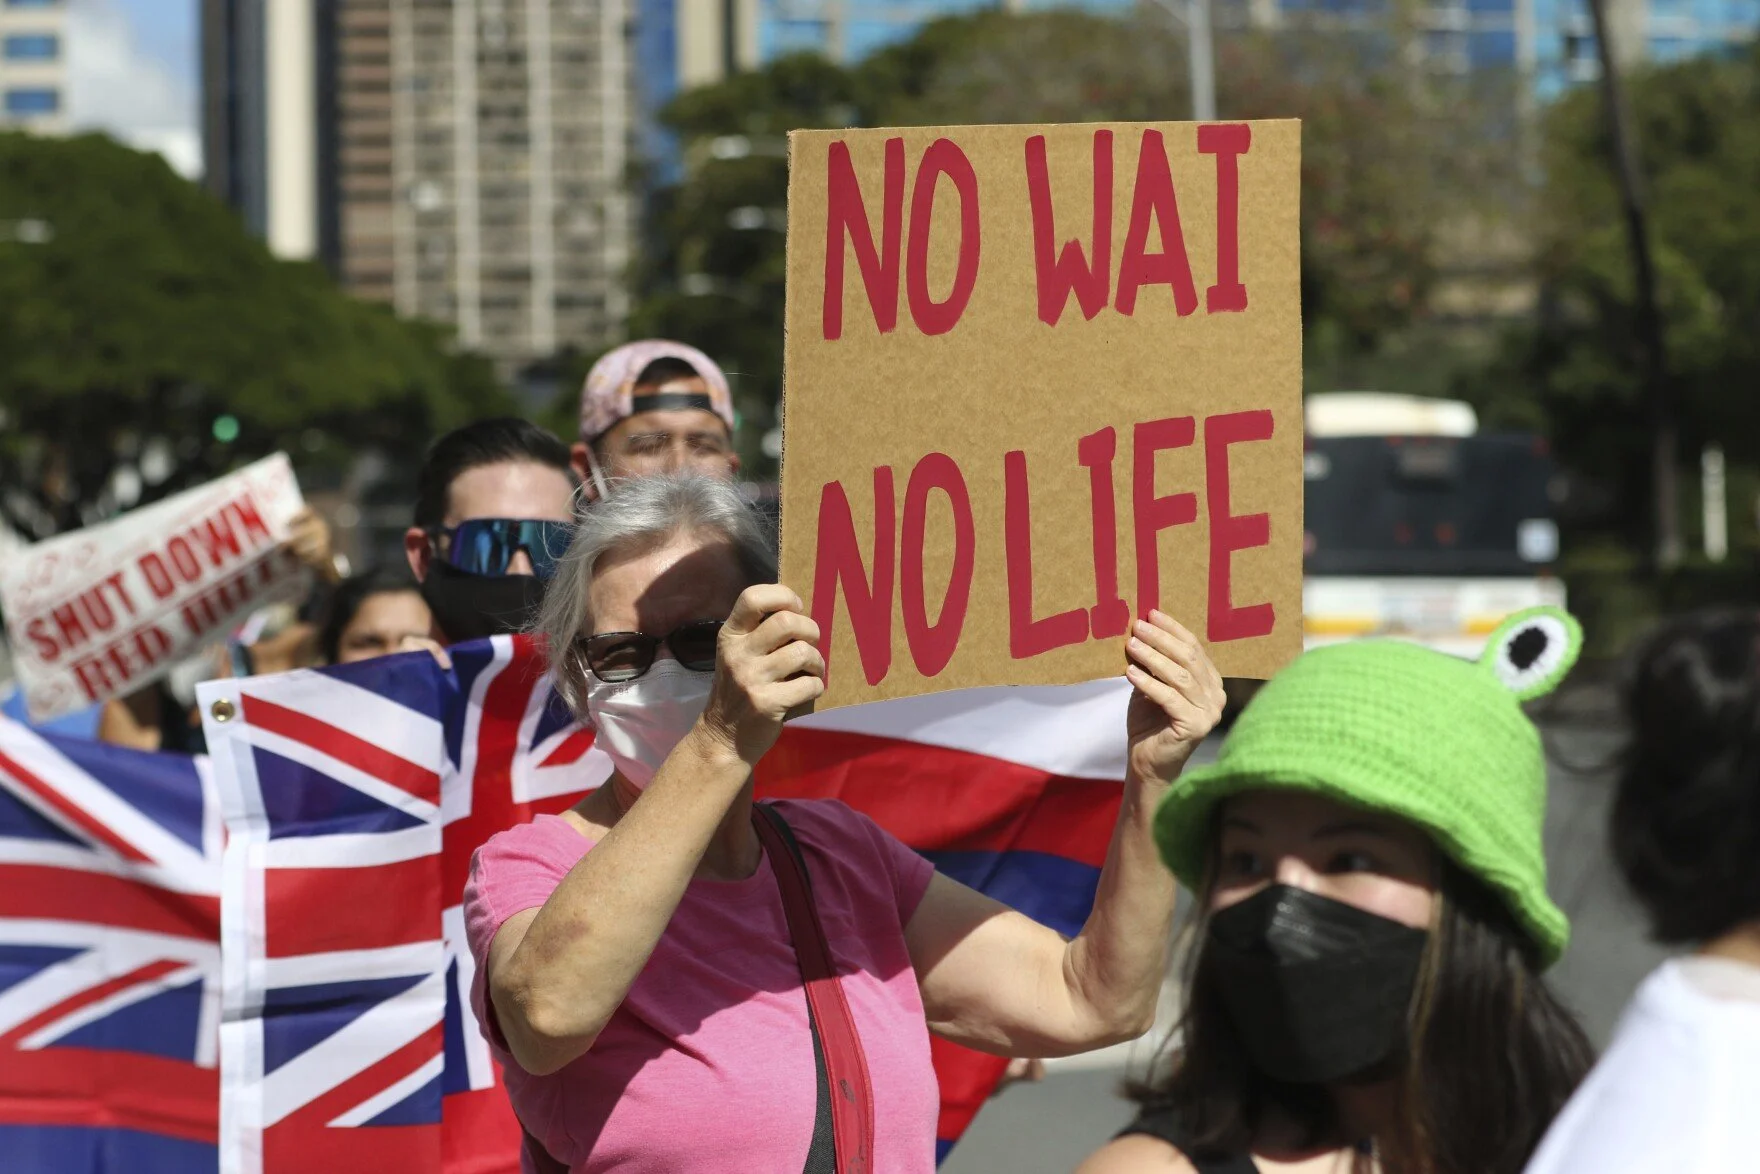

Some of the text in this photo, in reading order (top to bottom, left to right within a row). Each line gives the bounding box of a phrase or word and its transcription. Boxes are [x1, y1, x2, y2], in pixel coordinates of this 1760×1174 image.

[823, 123, 1251, 340] NO WAI
[25, 493, 271, 663] SHUT DOWN
[811, 409, 1275, 687] NO LIFE
[70, 619, 172, 702] RED
